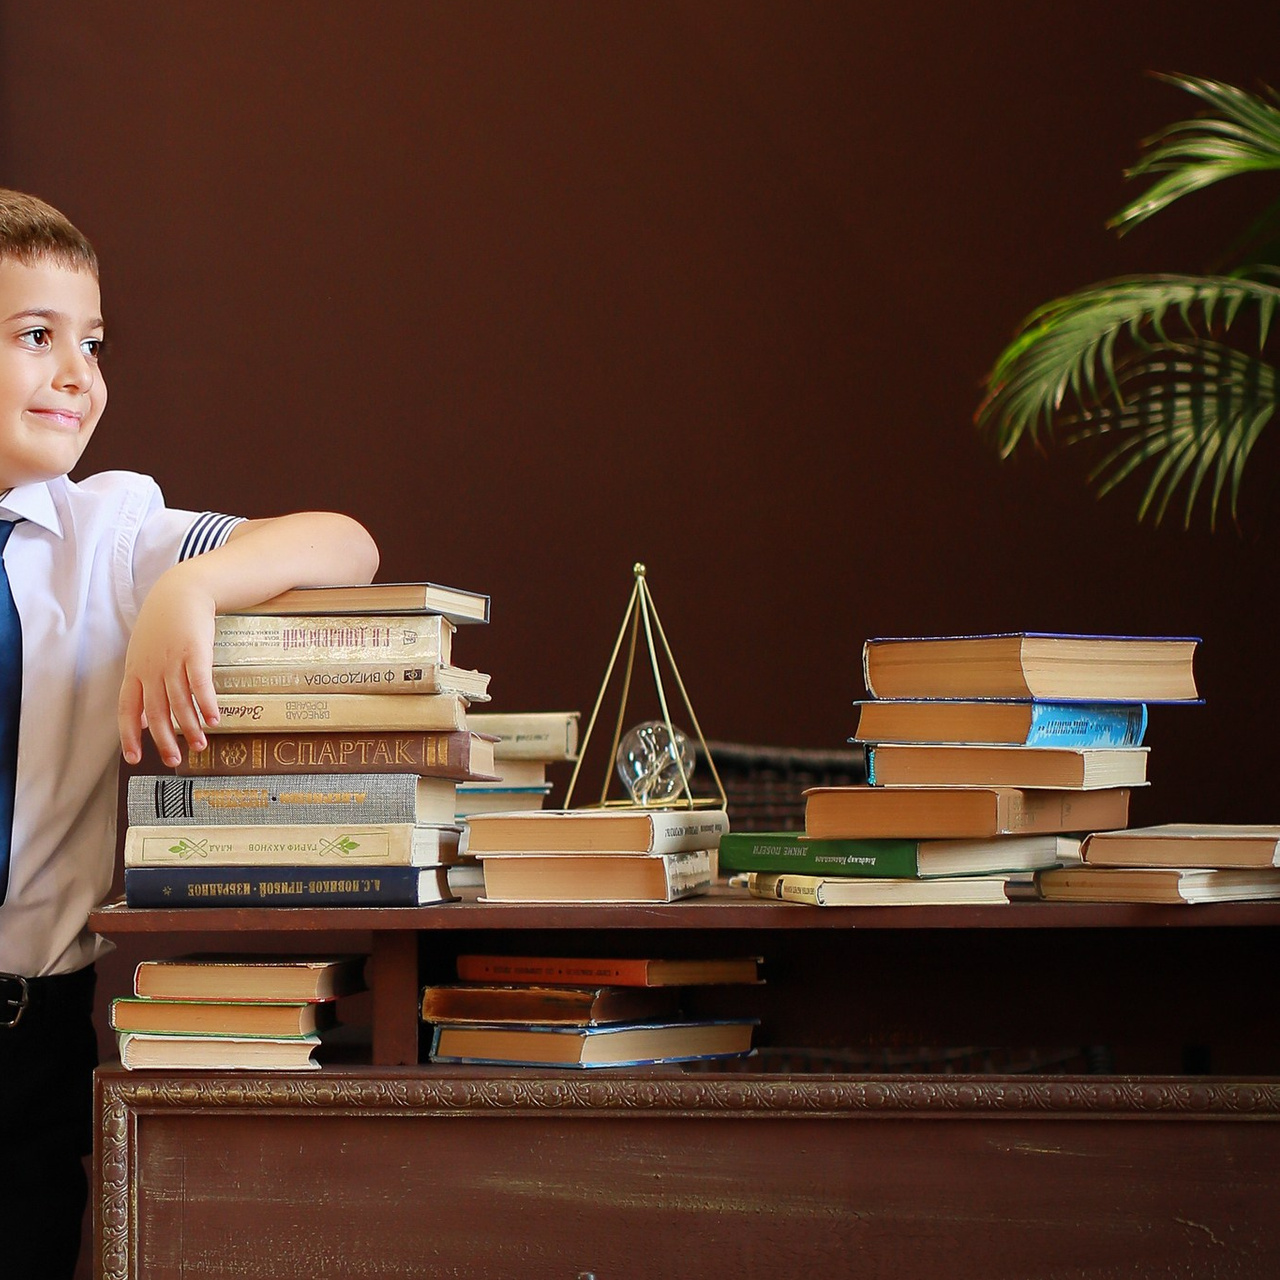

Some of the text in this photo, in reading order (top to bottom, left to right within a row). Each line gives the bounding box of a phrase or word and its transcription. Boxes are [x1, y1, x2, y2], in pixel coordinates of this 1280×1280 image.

[285, 700, 328, 711] ГОРБАЧЕВ
[285, 710, 330, 720] ВЯЧЕСЛАВ
[271, 739, 418, 768] СПАРТАК
[208, 842, 317, 852] ГАРИФ АХУНОВ КЛАД
[752, 845, 809, 857] ДИКИЕ ПОБЕГИ
[186, 881, 251, 896] ИЗБРАННОЕ
